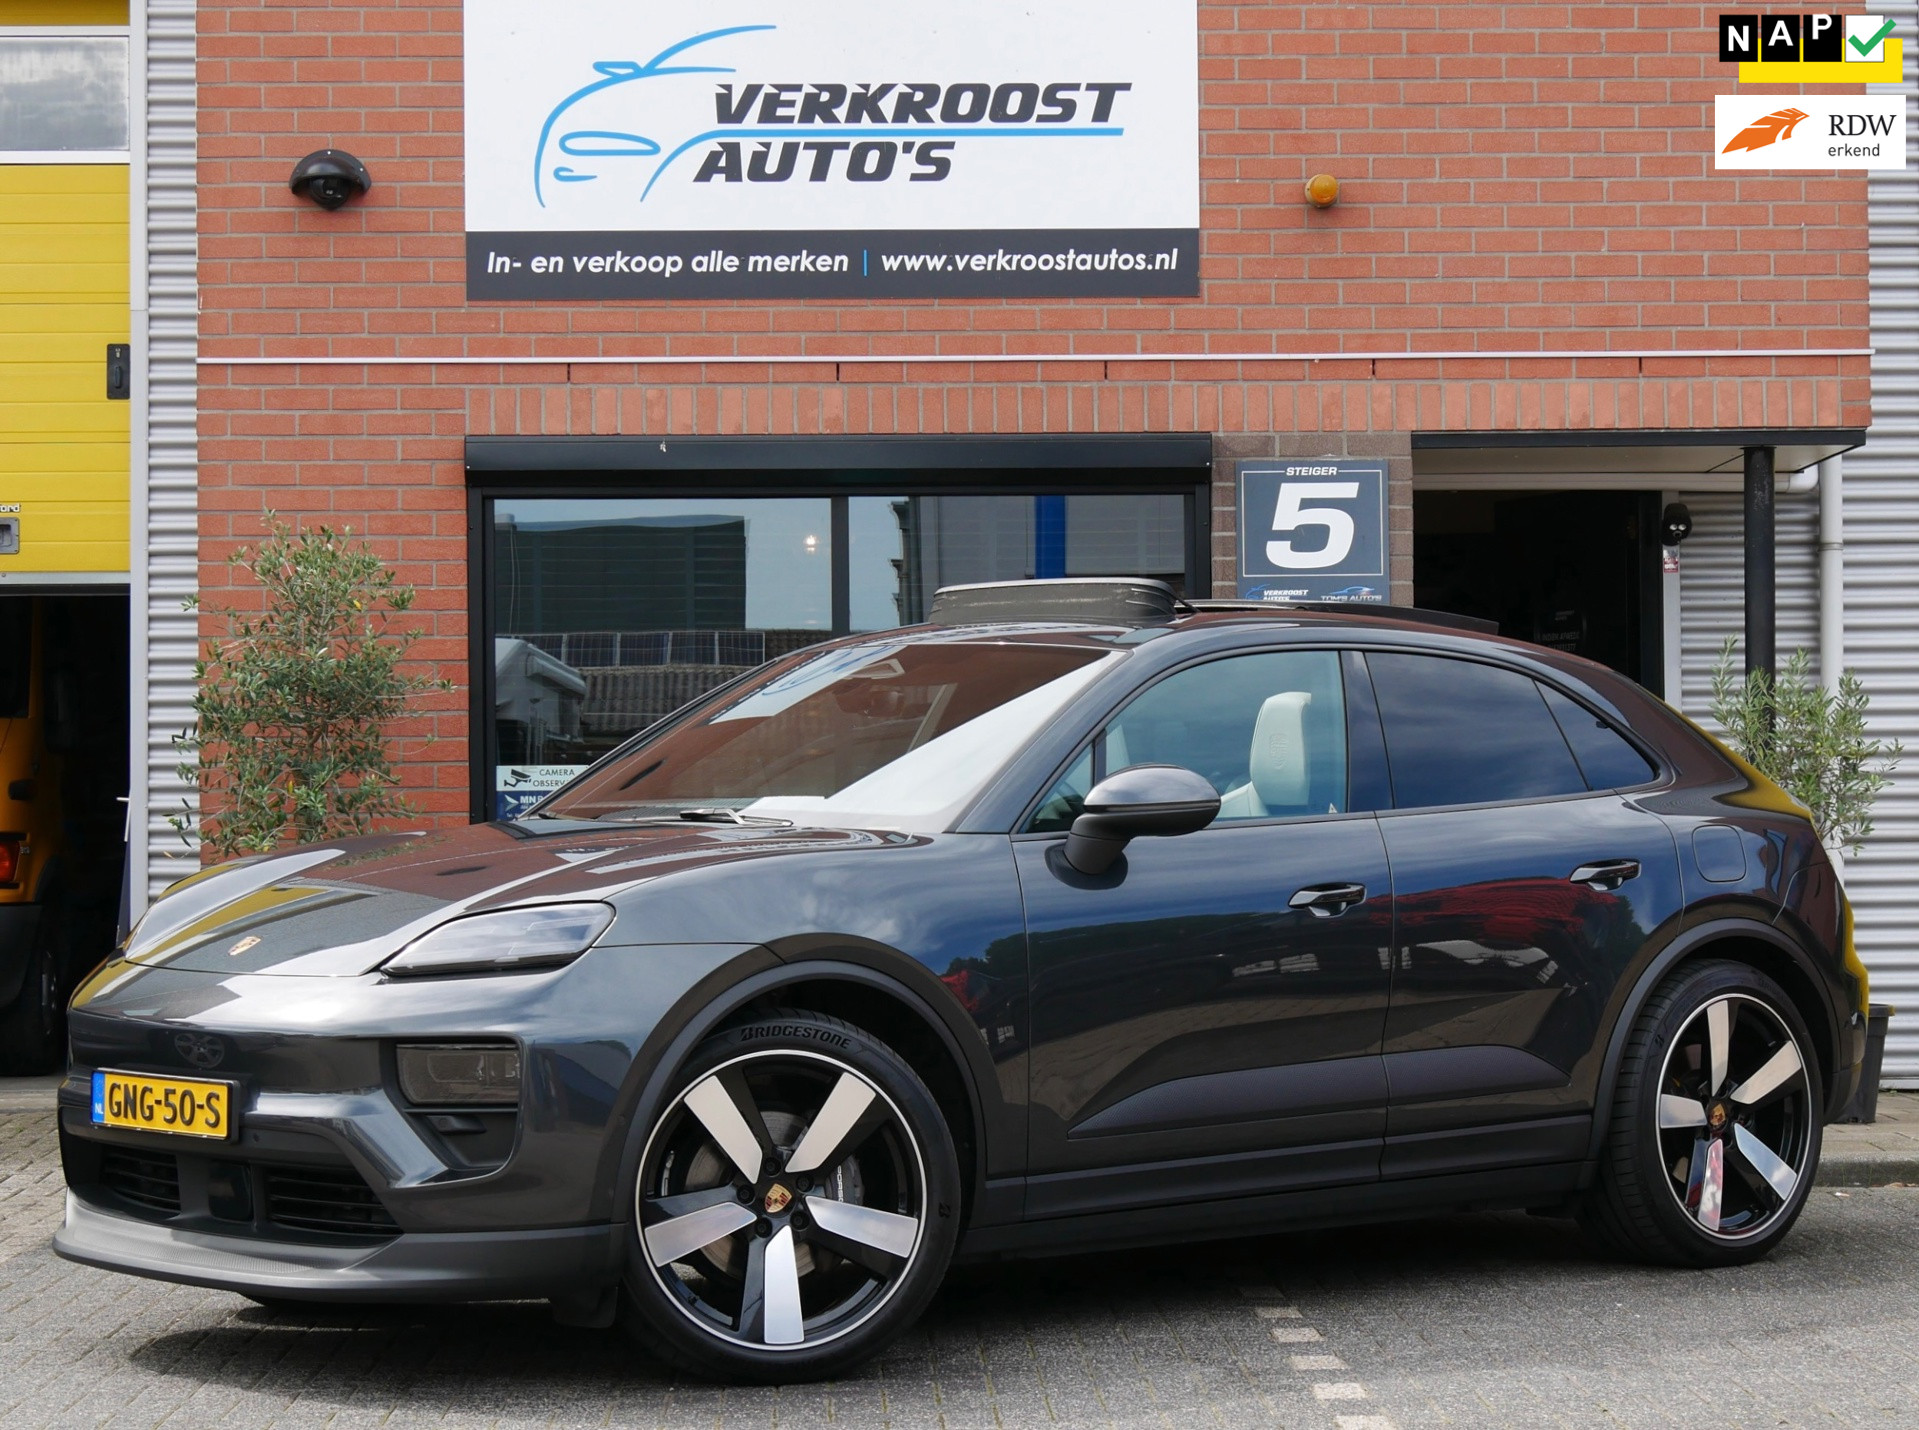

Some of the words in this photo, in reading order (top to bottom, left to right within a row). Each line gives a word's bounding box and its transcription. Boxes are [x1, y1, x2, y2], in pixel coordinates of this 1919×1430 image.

[715, 82, 1132, 124] VERKROOST
[693, 141, 956, 183] AUTO'S
[487, 251, 522, 274] In-
[530, 255, 564, 274] en
[572, 250, 683, 278] verkoop
[691, 249, 740, 273] alle
[747, 249, 849, 273] merken
[881, 247, 1179, 273] www.verkroostautos.nl
[1286, 466, 1338, 476] STEIGER
[1265, 481, 1360, 569] 5
[532, 779, 570, 788] OBSERV
[539, 768, 576, 777] CAMERA
[740, 1025, 852, 1049] BRIDGESTONE
[94, 1103, 104, 1115] NL
[108, 1082, 221, 1129] GNG-50-S
